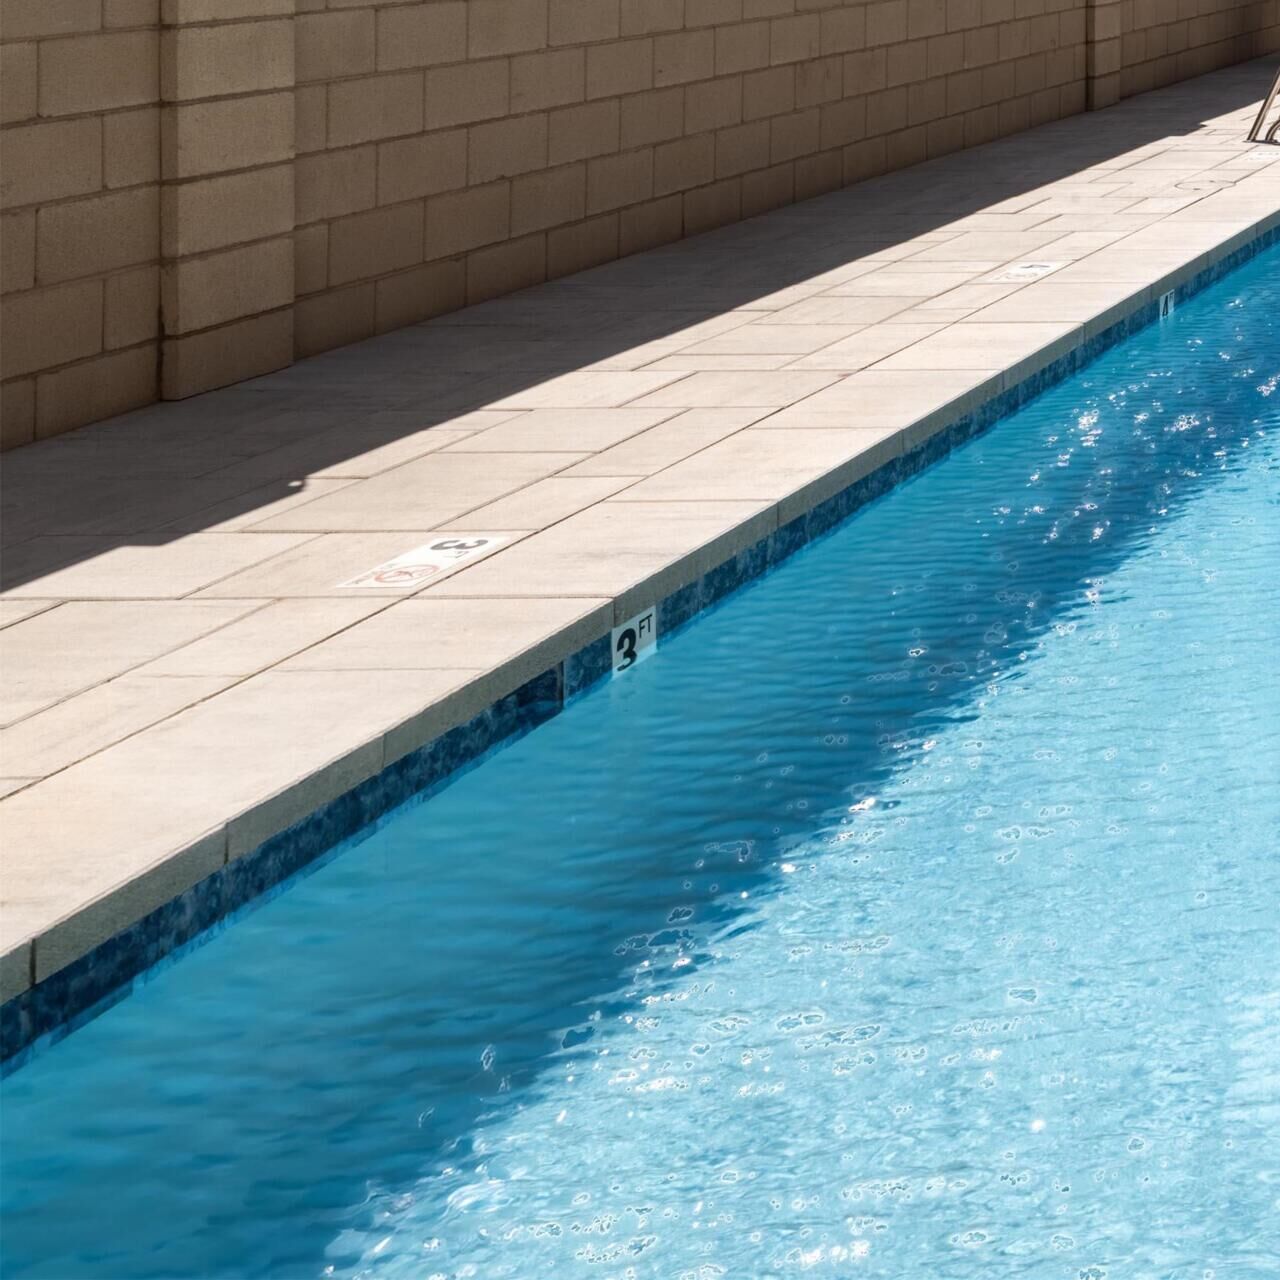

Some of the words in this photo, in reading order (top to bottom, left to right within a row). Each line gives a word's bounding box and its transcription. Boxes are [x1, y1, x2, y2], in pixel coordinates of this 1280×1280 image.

[430, 539, 489, 550] 3
[617, 628, 637, 671] 3
[639, 613, 652, 638] FT
